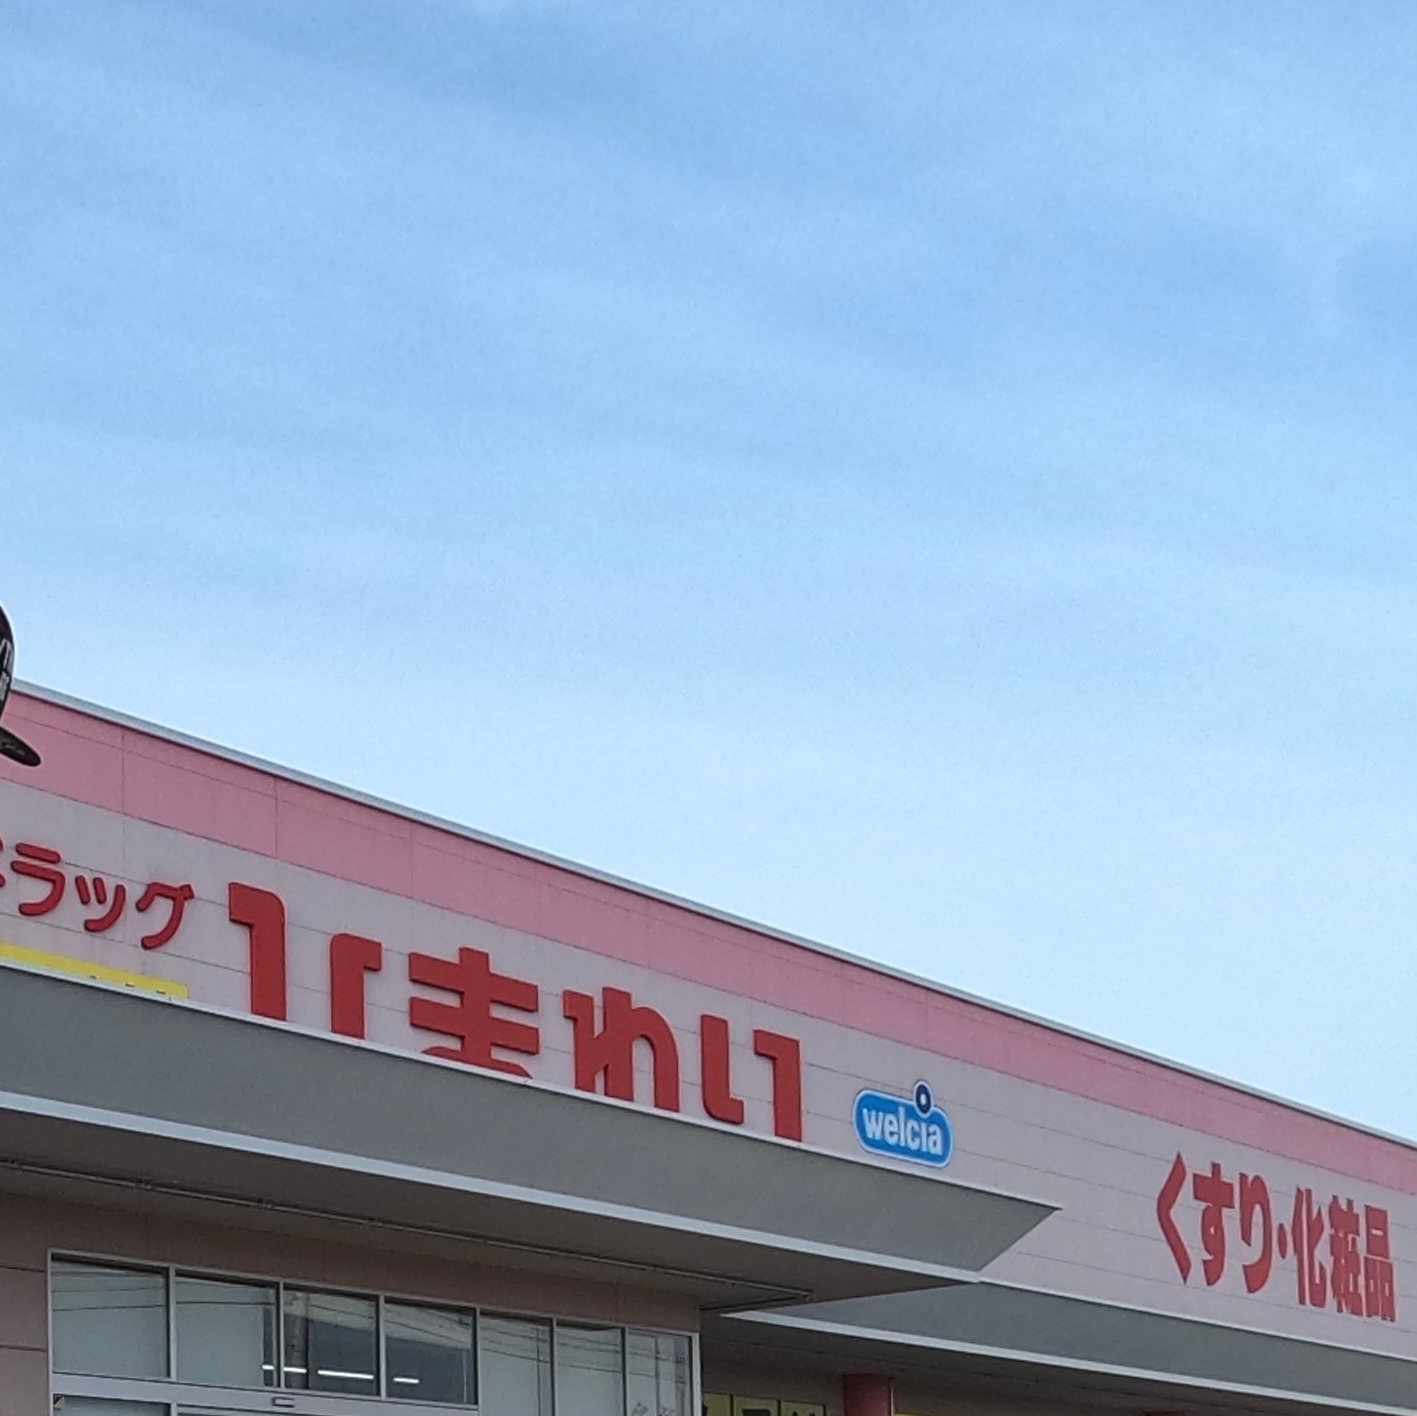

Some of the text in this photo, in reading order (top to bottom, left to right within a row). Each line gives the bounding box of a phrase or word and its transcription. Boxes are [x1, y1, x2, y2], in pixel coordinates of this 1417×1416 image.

[862, 1098, 943, 1156] welcia
[1156, 1151, 1397, 1322] くすり・化粧品
